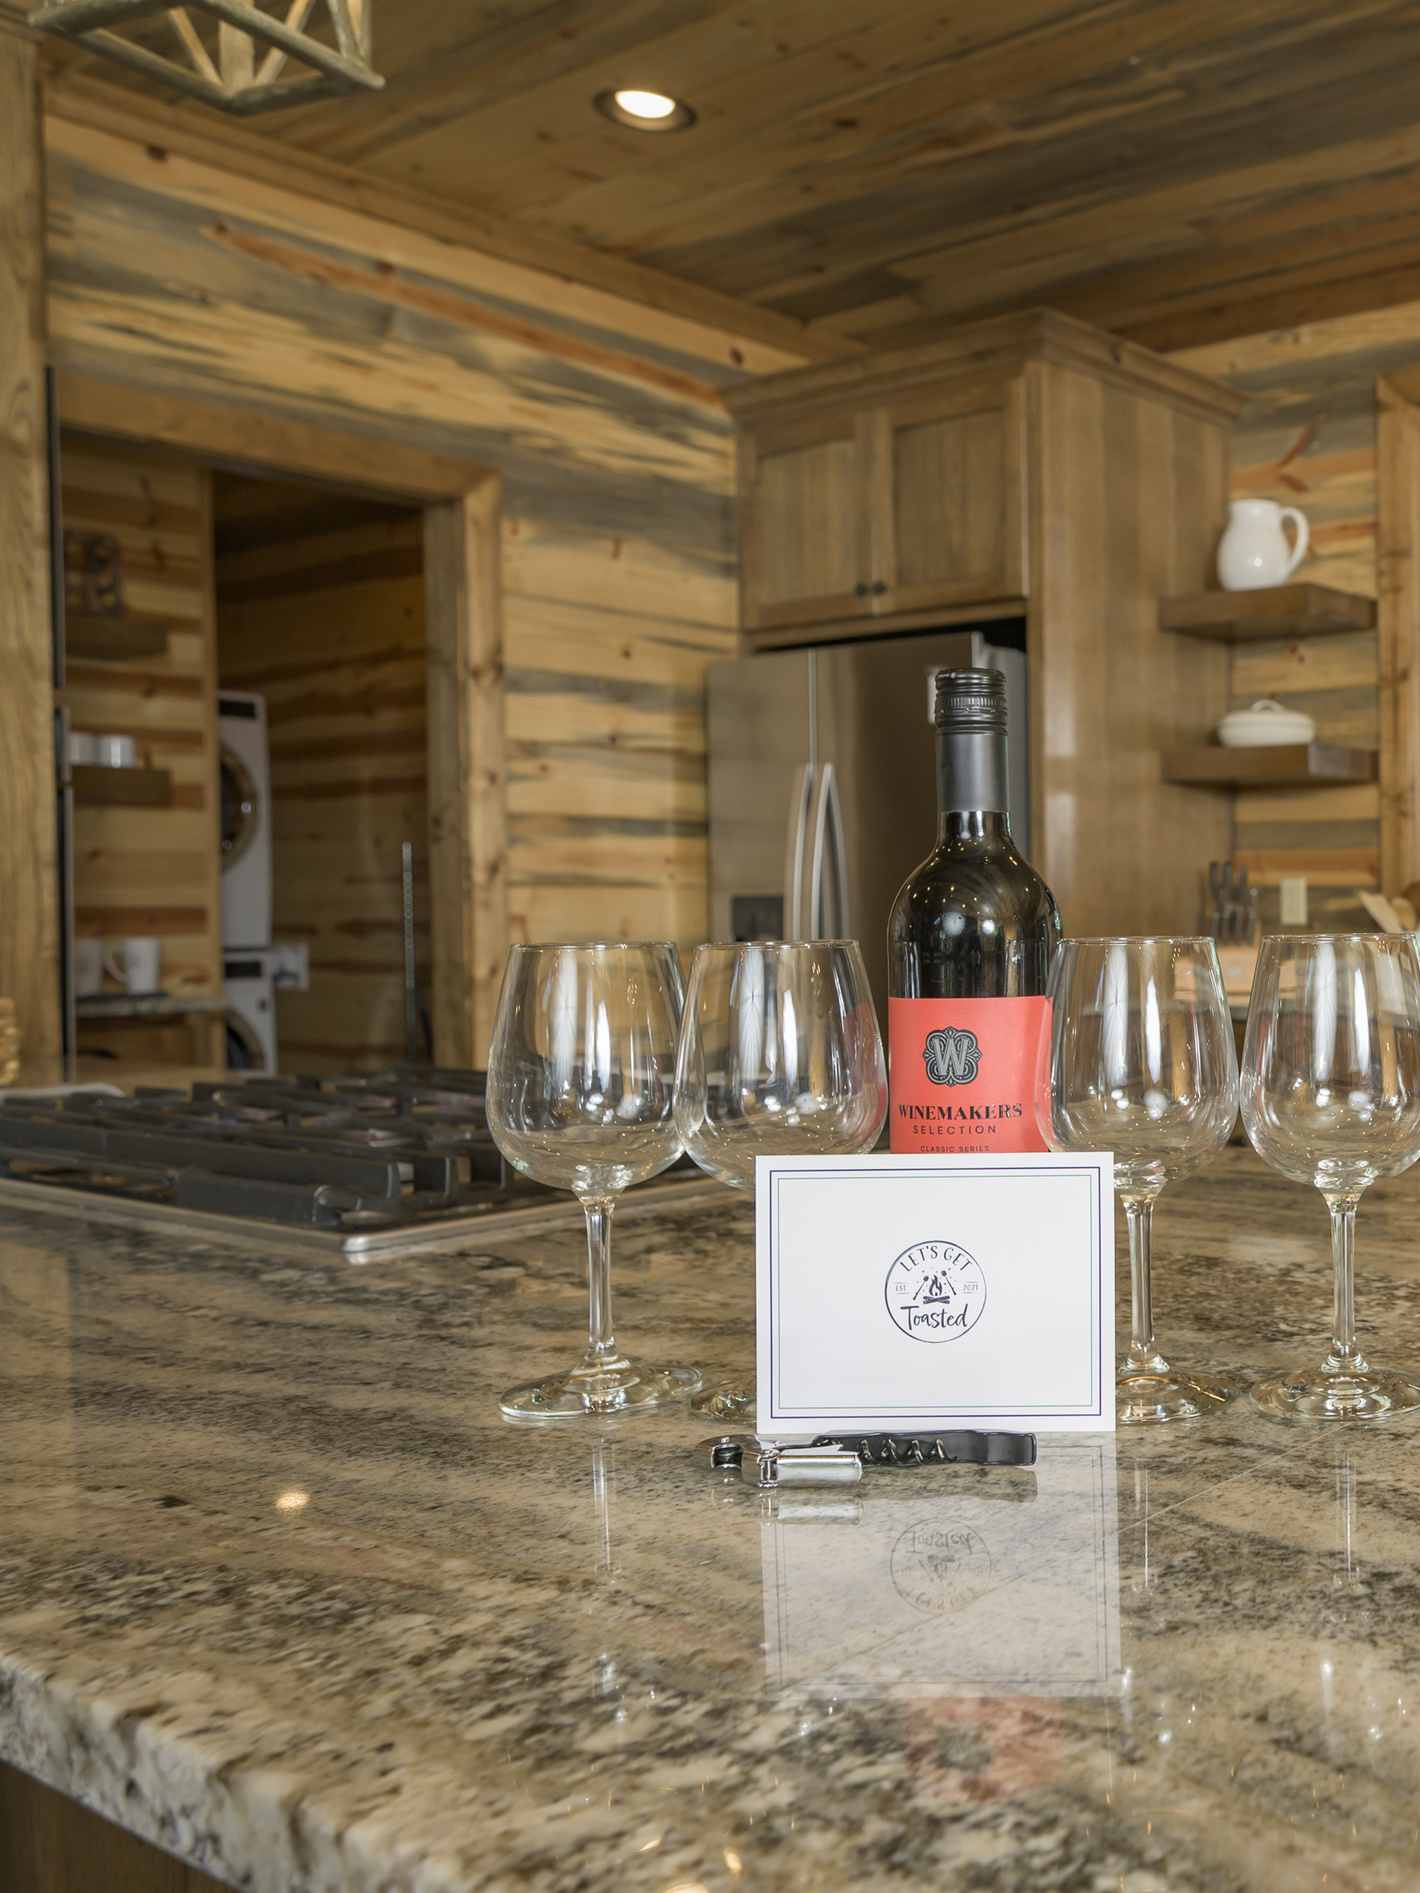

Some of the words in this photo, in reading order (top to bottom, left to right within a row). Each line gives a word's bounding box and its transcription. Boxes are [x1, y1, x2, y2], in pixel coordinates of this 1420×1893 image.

[931, 1036, 970, 1076] W
[898, 1103, 1023, 1121] WINEMAKERS
[913, 1125, 996, 1135] SELECTION
[920, 1145, 955, 1153] CLASSIC
[959, 1145, 990, 1153] SERIES
[899, 1245, 938, 1272] LET'S
[943, 1247, 973, 1271] GET
[895, 1284, 907, 1292] EST
[963, 1283, 979, 1291] 2021
[900, 1303, 968, 1330] Toasted
